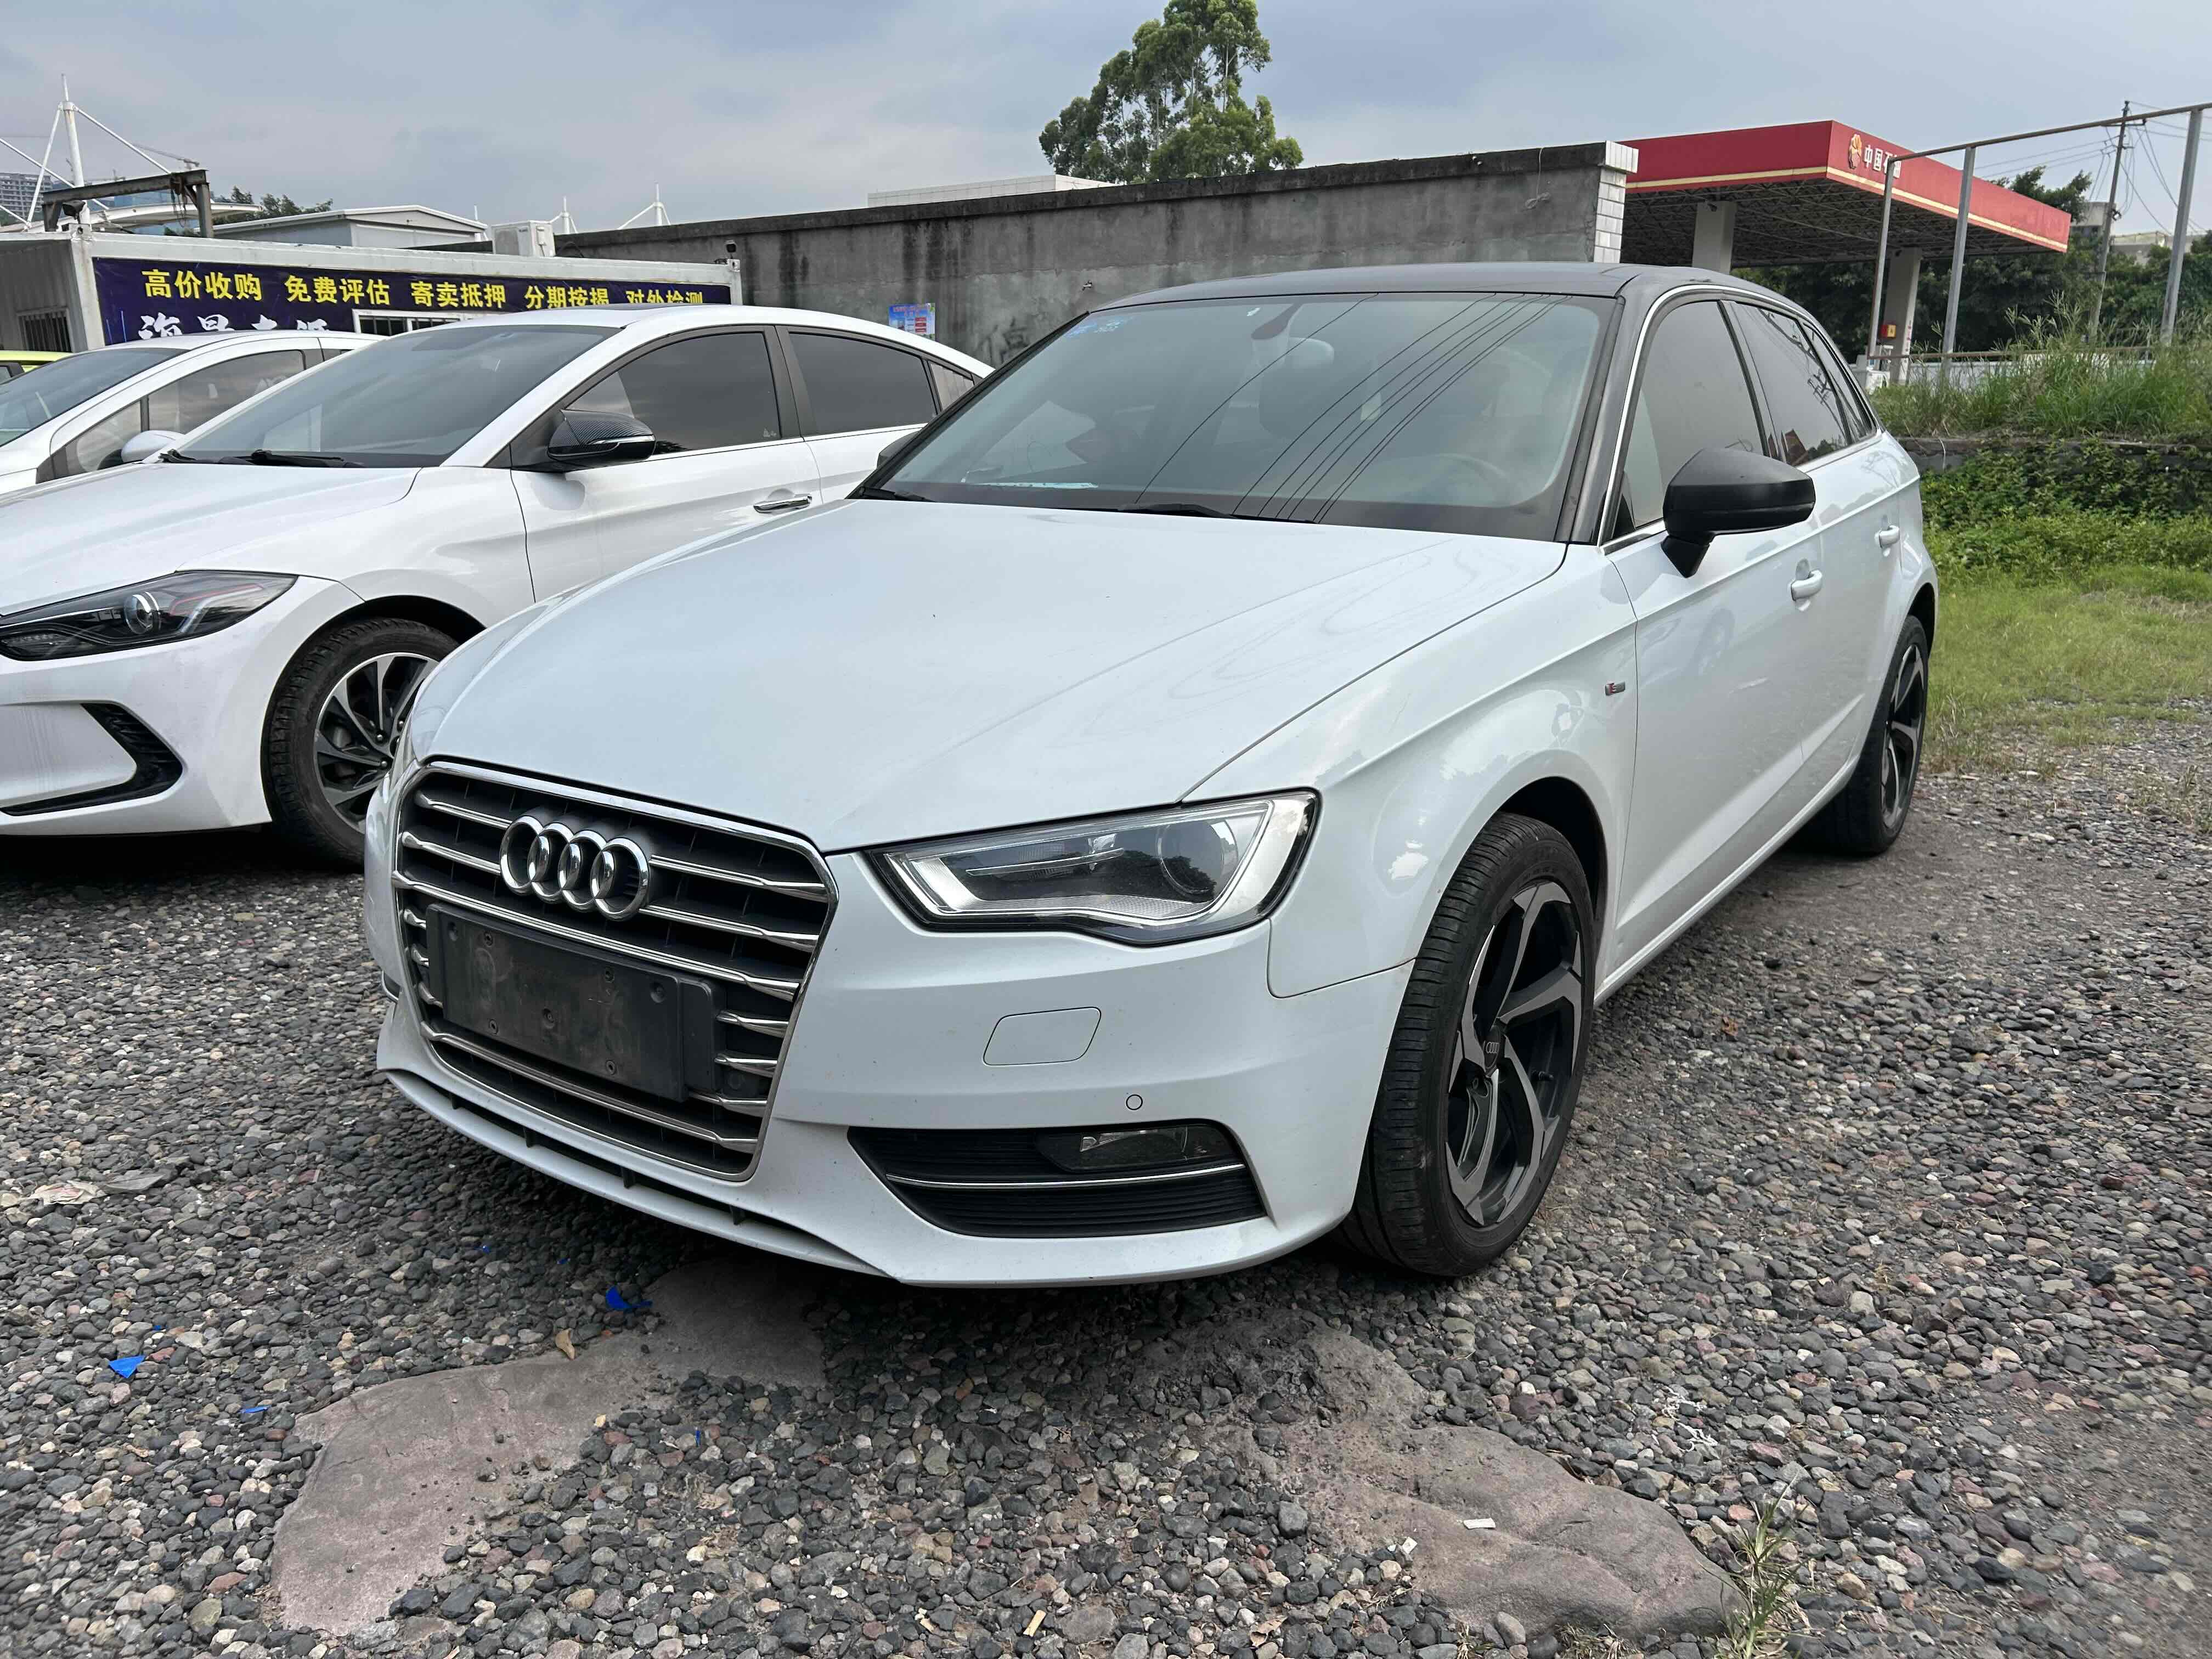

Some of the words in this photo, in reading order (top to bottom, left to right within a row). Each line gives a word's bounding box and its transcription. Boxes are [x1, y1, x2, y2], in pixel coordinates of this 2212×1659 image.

[142, 269, 262, 301] 高价收购
[284, 275, 390, 305] 免费评估
[410, 281, 506, 308] 寄卖抵押
[524, 285, 610, 309] 分期按揭
[625, 289, 703, 303] 对外检测
